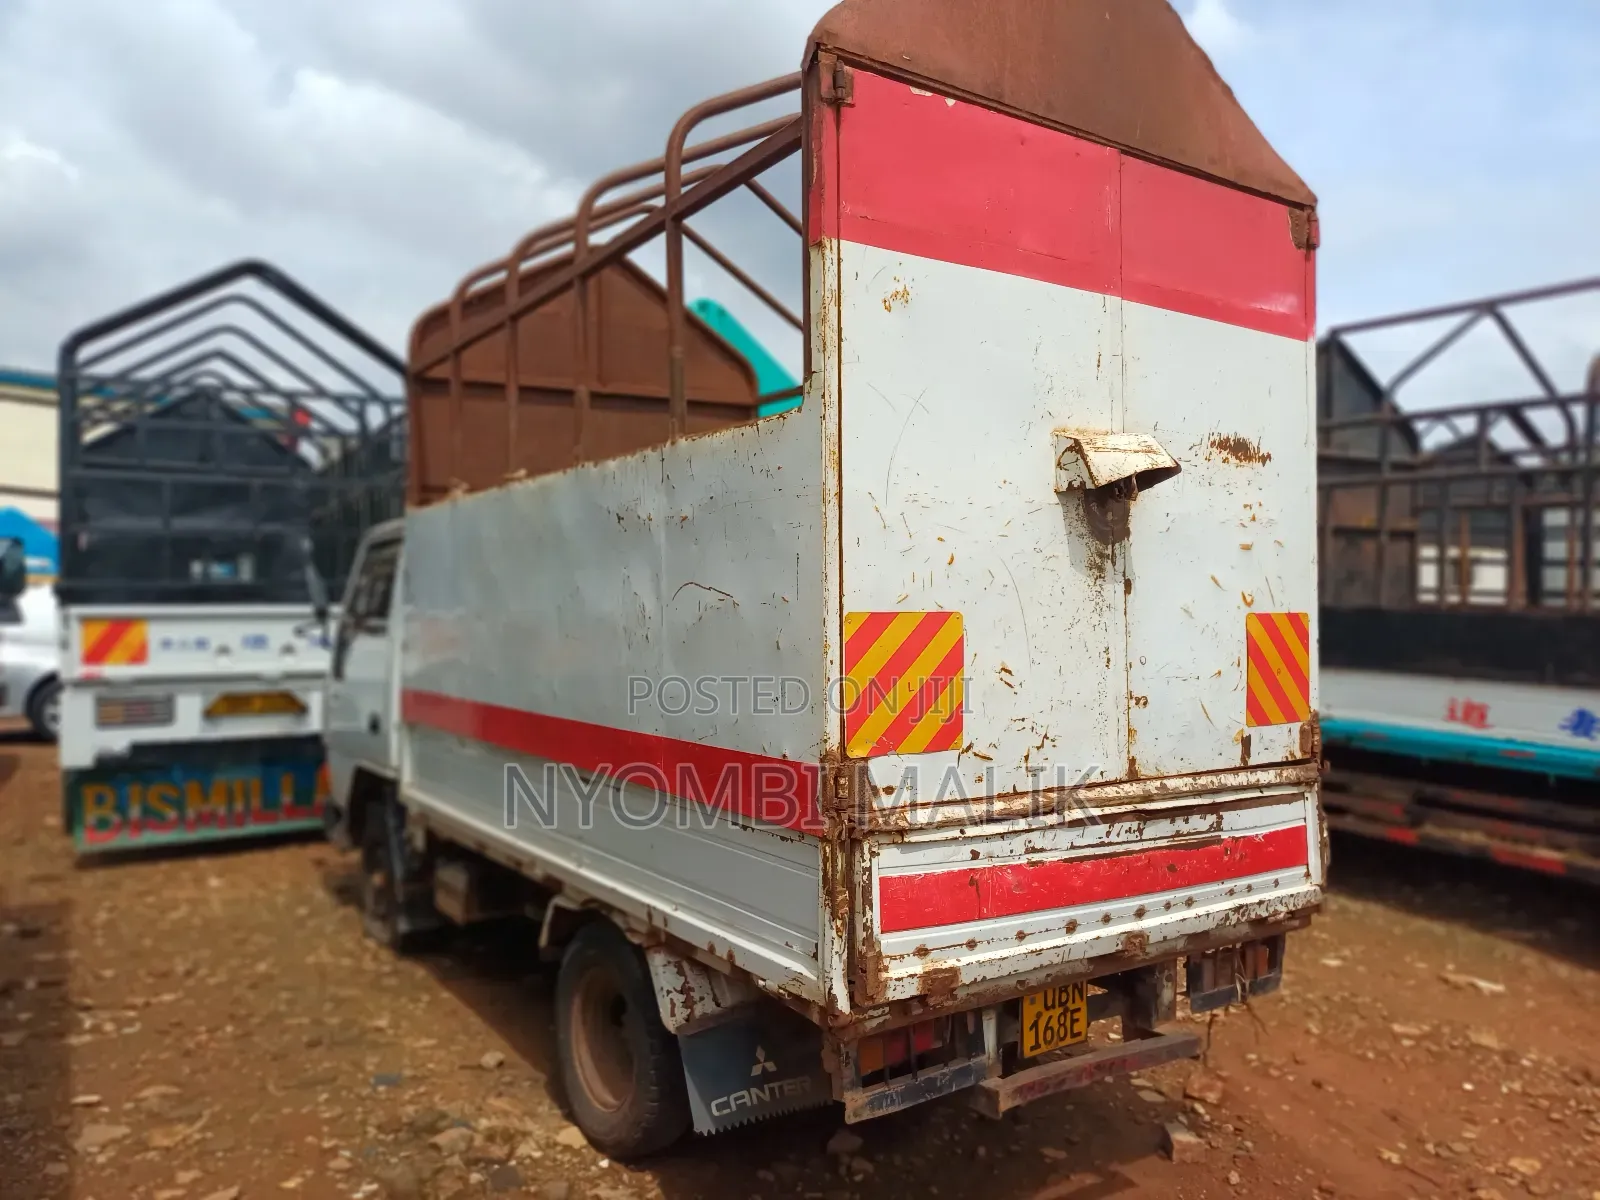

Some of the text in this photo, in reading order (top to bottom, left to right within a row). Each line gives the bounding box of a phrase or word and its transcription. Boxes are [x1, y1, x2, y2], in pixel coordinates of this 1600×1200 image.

[1043, 981, 1084, 1012] UBN
[1028, 1007, 1083, 1053] 168E
[710, 1075, 813, 1117] CANTER
